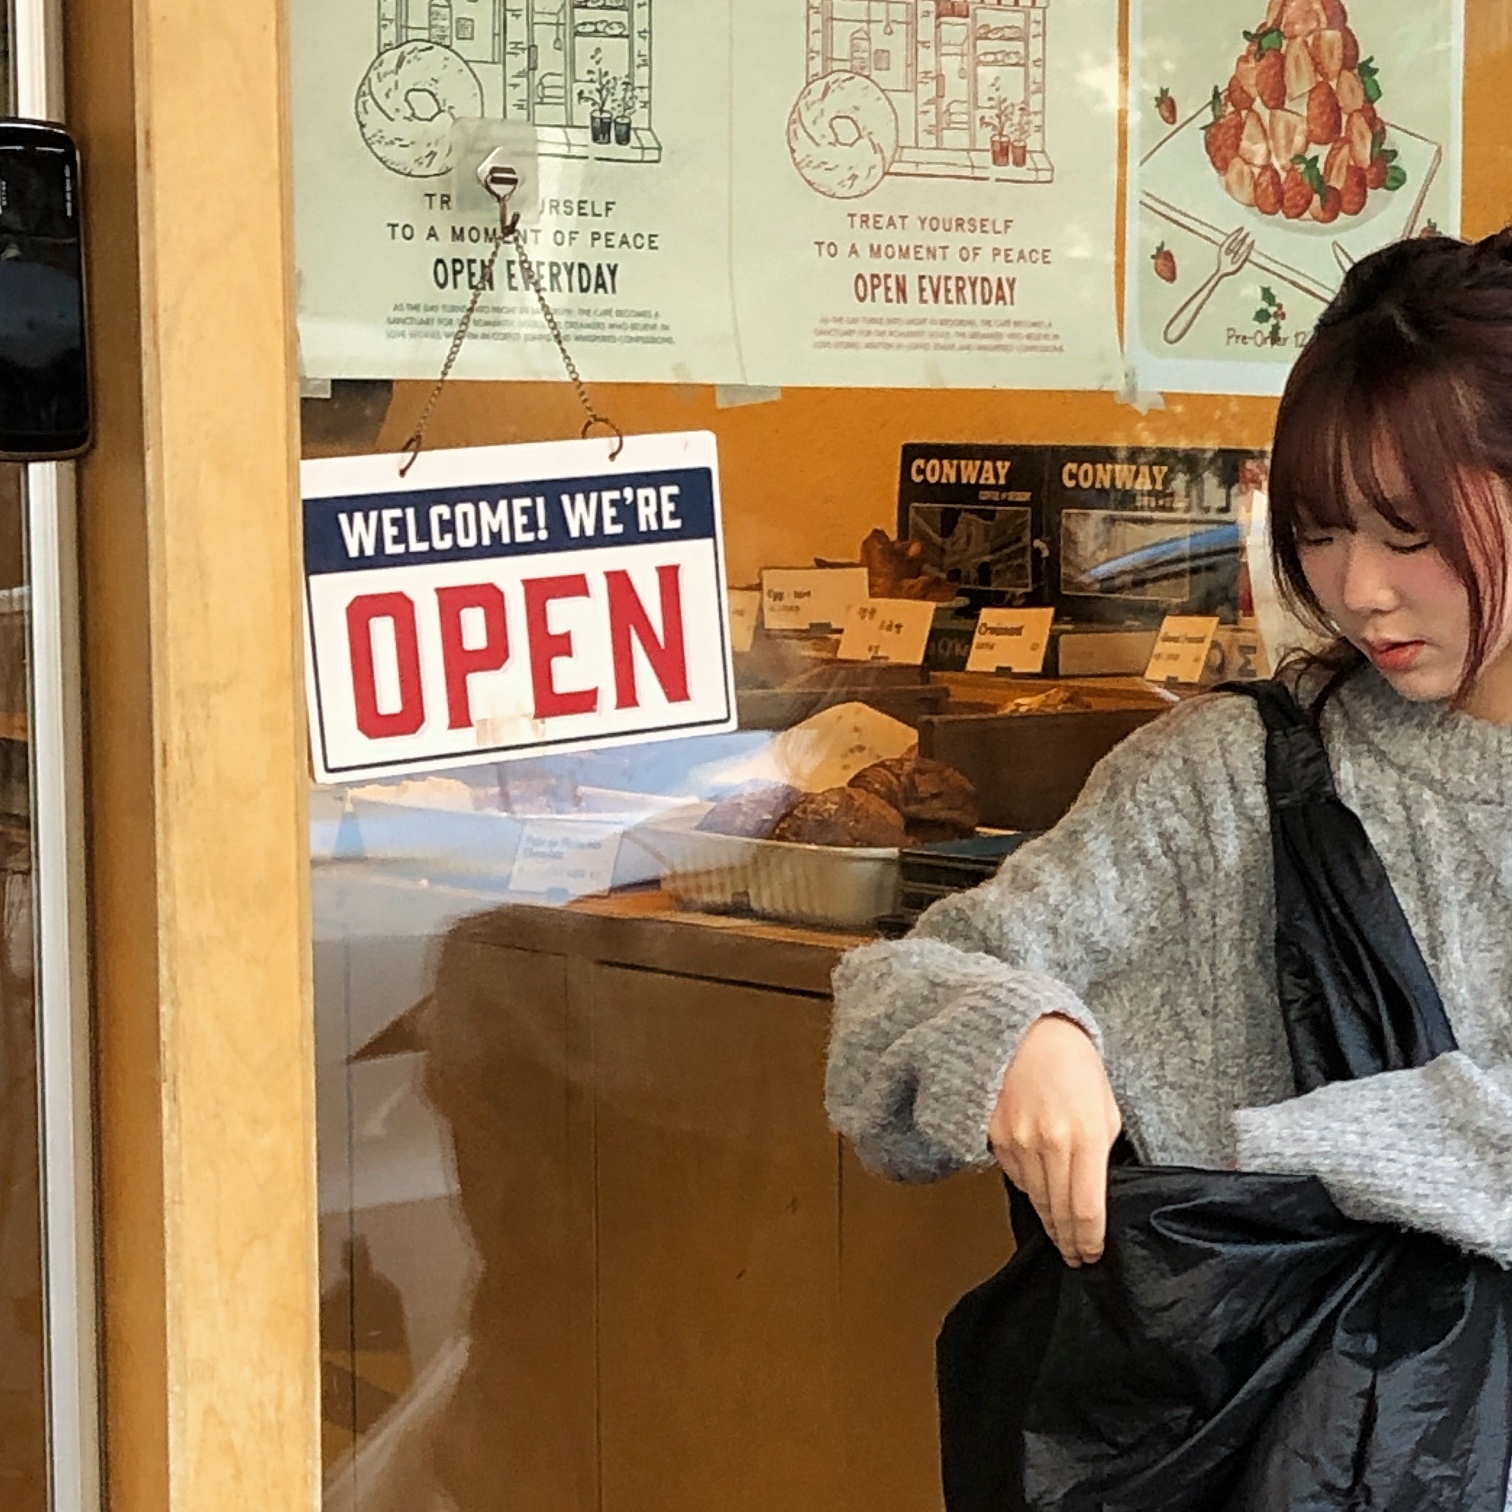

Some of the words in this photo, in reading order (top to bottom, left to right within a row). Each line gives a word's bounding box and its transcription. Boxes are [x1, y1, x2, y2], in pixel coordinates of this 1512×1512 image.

[387, 223, 414, 241] TO
[426, 225, 439, 241] A
[553, 230, 579, 246] OF
[591, 231, 659, 250] PEACE
[847, 213, 909, 230] TREAT
[918, 215, 1014, 235] YOURSELF
[814, 241, 838, 258] TO
[848, 243, 860, 258] A
[869, 243, 949, 261] MOMENT
[959, 246, 982, 262] OF
[992, 247, 1051, 264] PEACE
[433, 258, 494, 291] OPEN
[854, 273, 907, 304] OPEN
[918, 275, 1017, 306] EVERYDAY
[911, 458, 1011, 485] CONWAY
[1062, 462, 1168, 490] CONWAY
[338, 496, 548, 558] WELCOME!
[561, 486, 682, 538] WE'RE
[345, 564, 690, 739] OPEN
